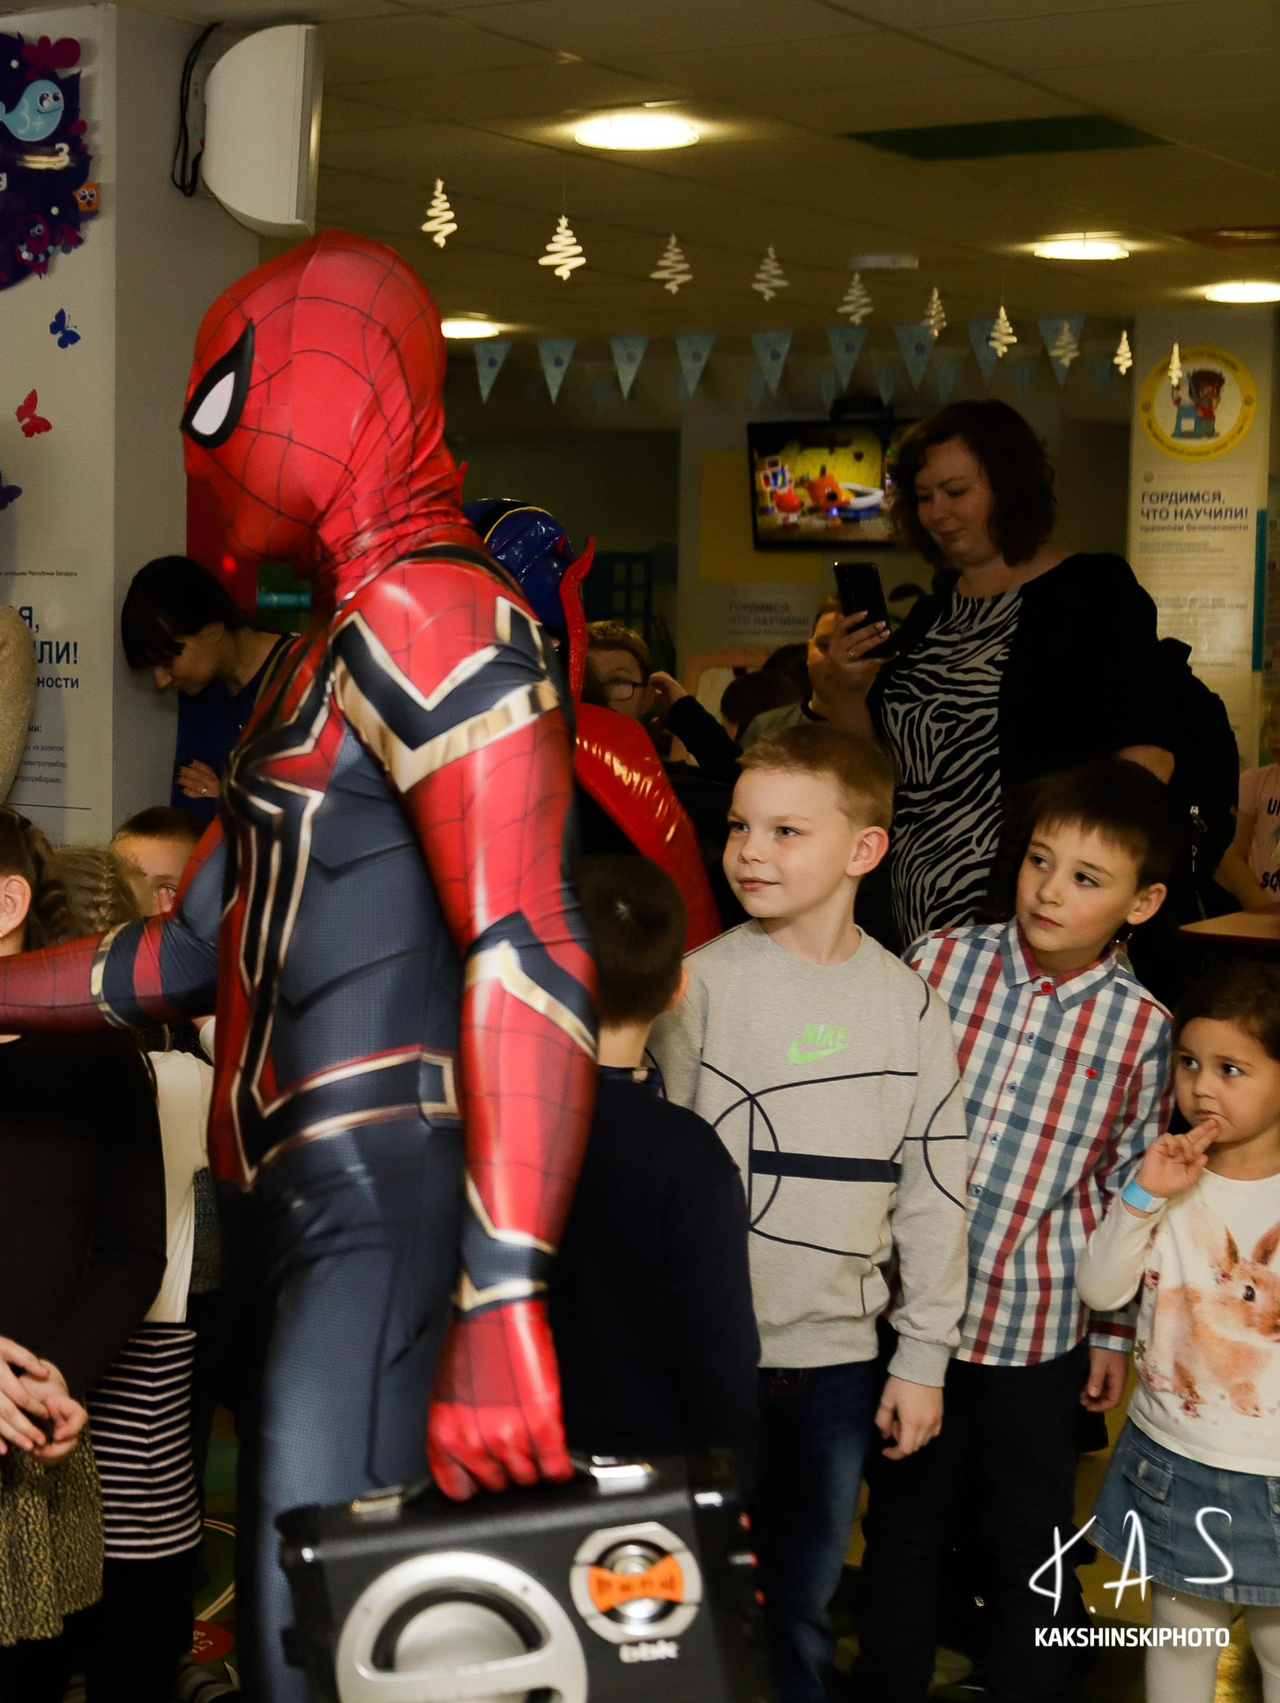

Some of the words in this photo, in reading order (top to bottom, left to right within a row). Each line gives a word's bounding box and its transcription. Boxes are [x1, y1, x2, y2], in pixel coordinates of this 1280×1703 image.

[54, 143, 70, 169] 3
[1141, 491, 1225, 505] ГОРДИМСЯ,
[1141, 508, 1169, 520] ЧТО
[1174, 507, 1249, 520] НАУЧИЛИ!
[33, 640, 78, 665] ЛИ!
